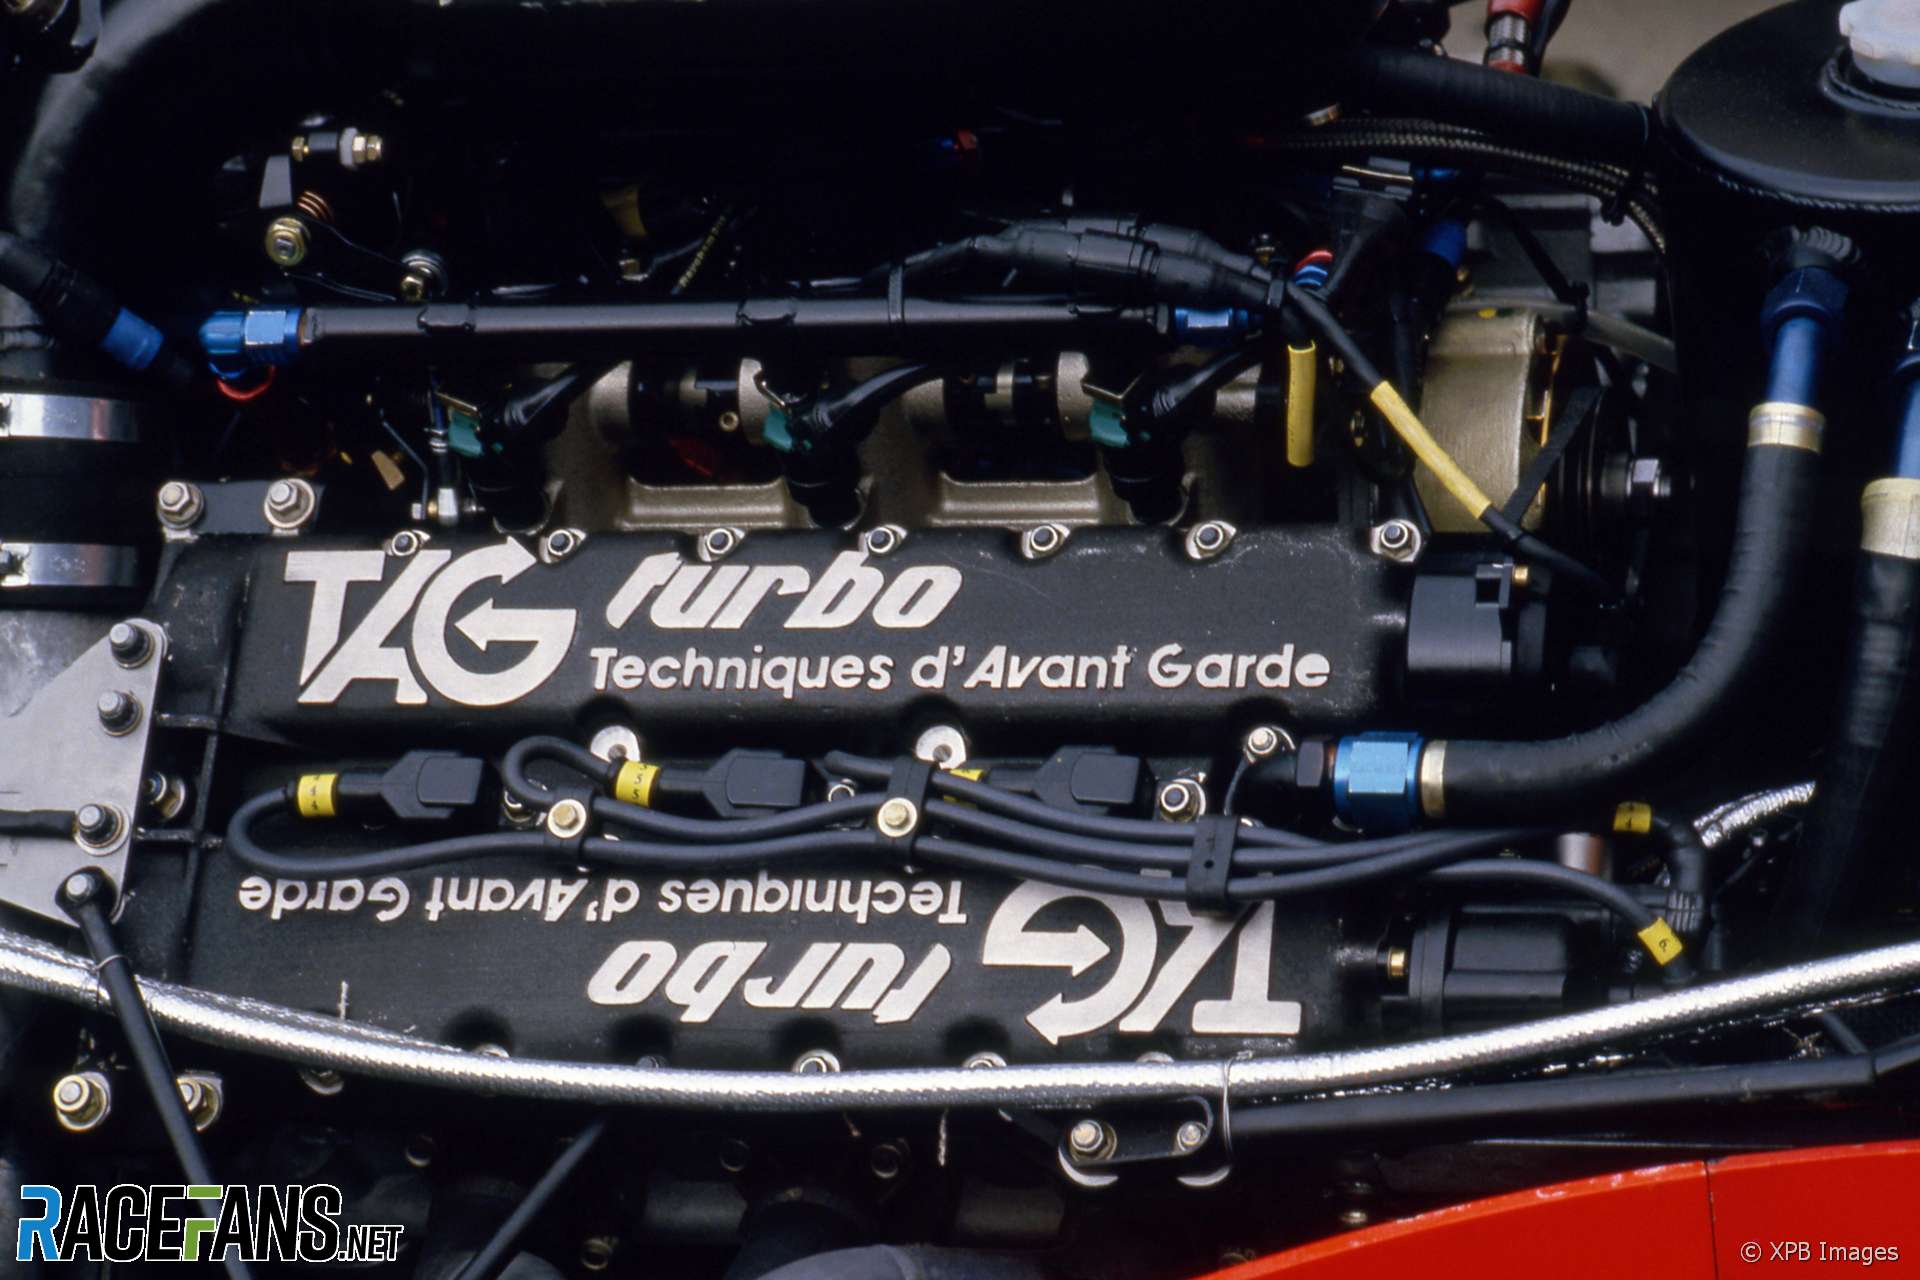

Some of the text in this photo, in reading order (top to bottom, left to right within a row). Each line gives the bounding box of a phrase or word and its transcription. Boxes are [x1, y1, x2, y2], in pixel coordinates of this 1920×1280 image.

[284, 535, 963, 706] TAG turbo
[591, 645, 894, 699] Techniques
[1148, 643, 1331, 689] Garde
[239, 876, 410, 923] Garde
[657, 872, 968, 925] Techniques
[586, 940, 952, 1024] turbo
